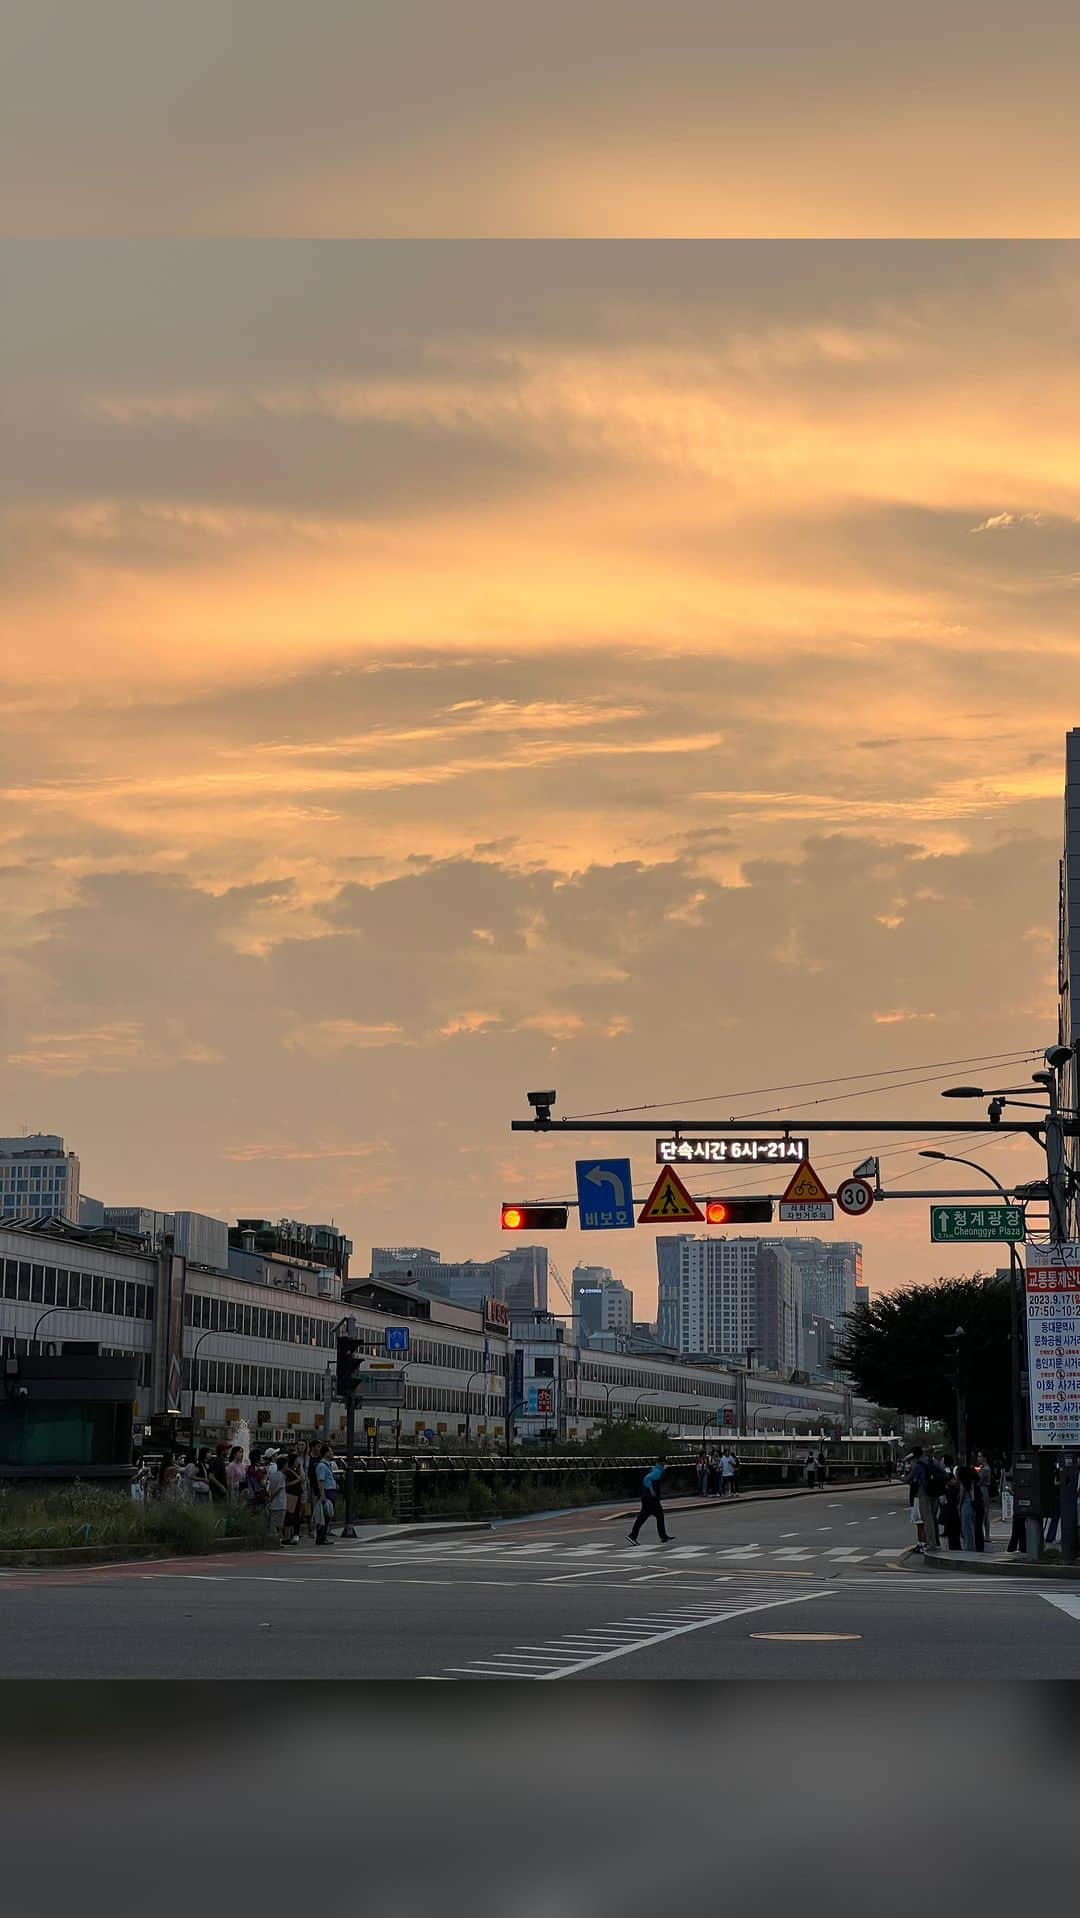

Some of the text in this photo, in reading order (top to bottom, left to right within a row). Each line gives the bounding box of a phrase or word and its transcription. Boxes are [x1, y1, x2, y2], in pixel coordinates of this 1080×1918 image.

[660, 1141, 803, 1160] 단속시간 6시~21시
[845, 1188, 866, 1205] 30
[585, 1211, 629, 1226] 비보호
[954, 1210, 1020, 1226] 청계광장
[954, 1226, 1020, 1238] Cheonggye Plaza
[1041, 1321, 1075, 1333] 동대문역사
[1036, 1380, 1054, 1391] 이화
[1038, 1402, 1080, 1414] 경복궁 사거
